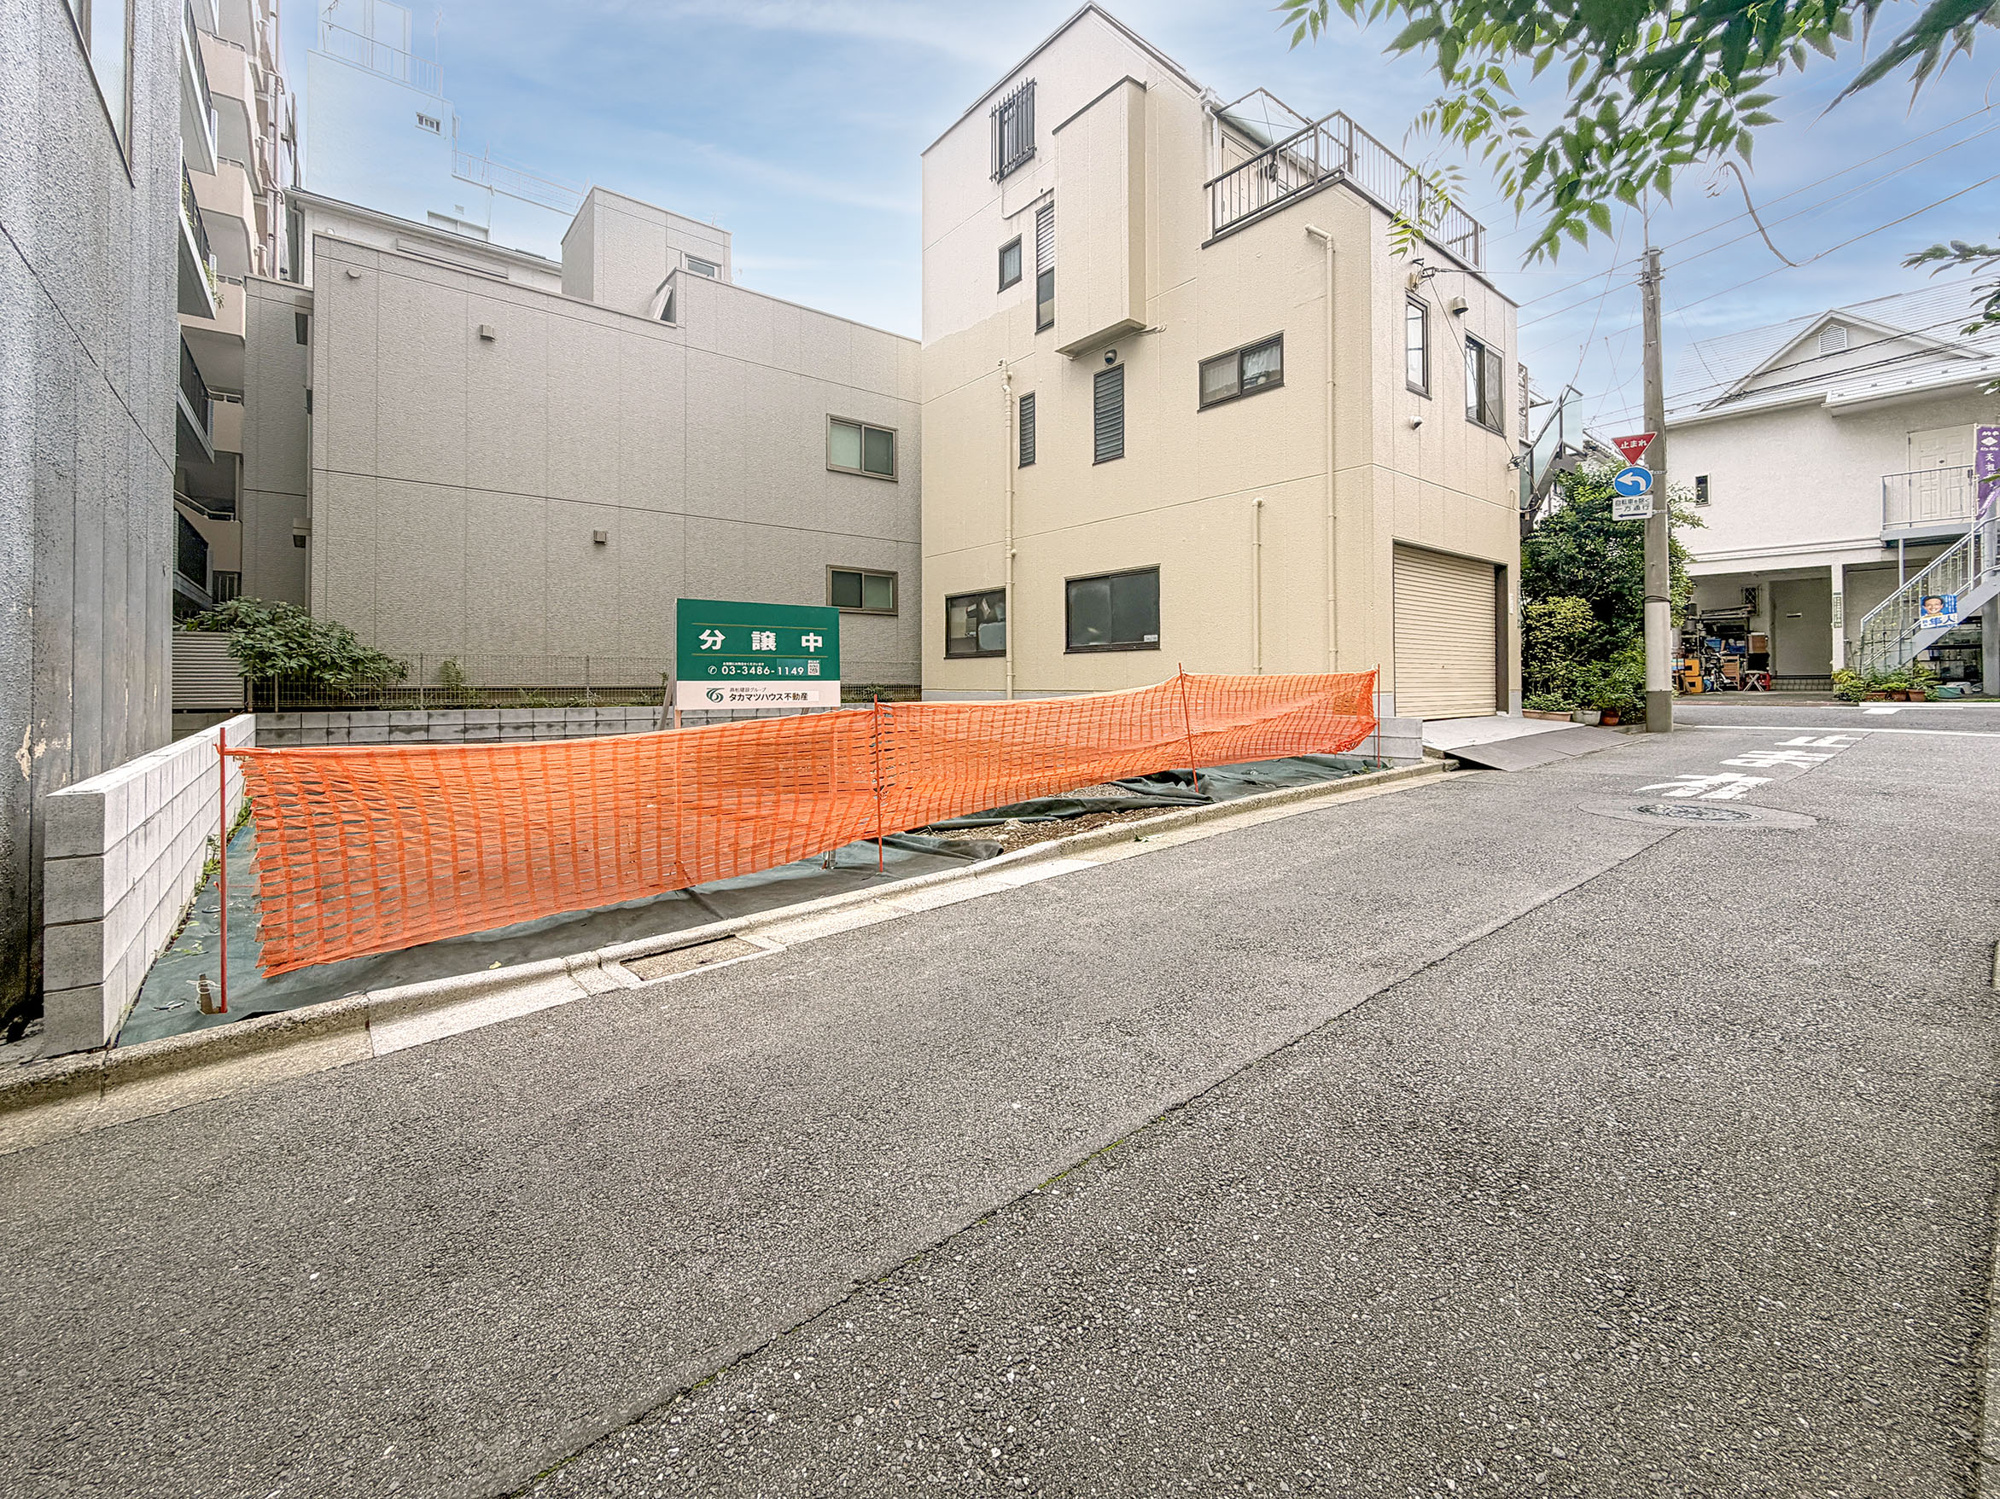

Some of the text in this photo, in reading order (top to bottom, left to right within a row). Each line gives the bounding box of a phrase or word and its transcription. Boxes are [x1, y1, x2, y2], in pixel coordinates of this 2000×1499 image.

[1620, 439, 1647, 449] 止まれ
[1615, 504, 1650, 512] 一方通行
[698, 629, 823, 653] 分譲中
[721, 666, 804, 676] 03-3486-1149
[729, 693, 809, 702] タカマツハウス不動産
[1634, 734, 1863, 800] 止まれ
